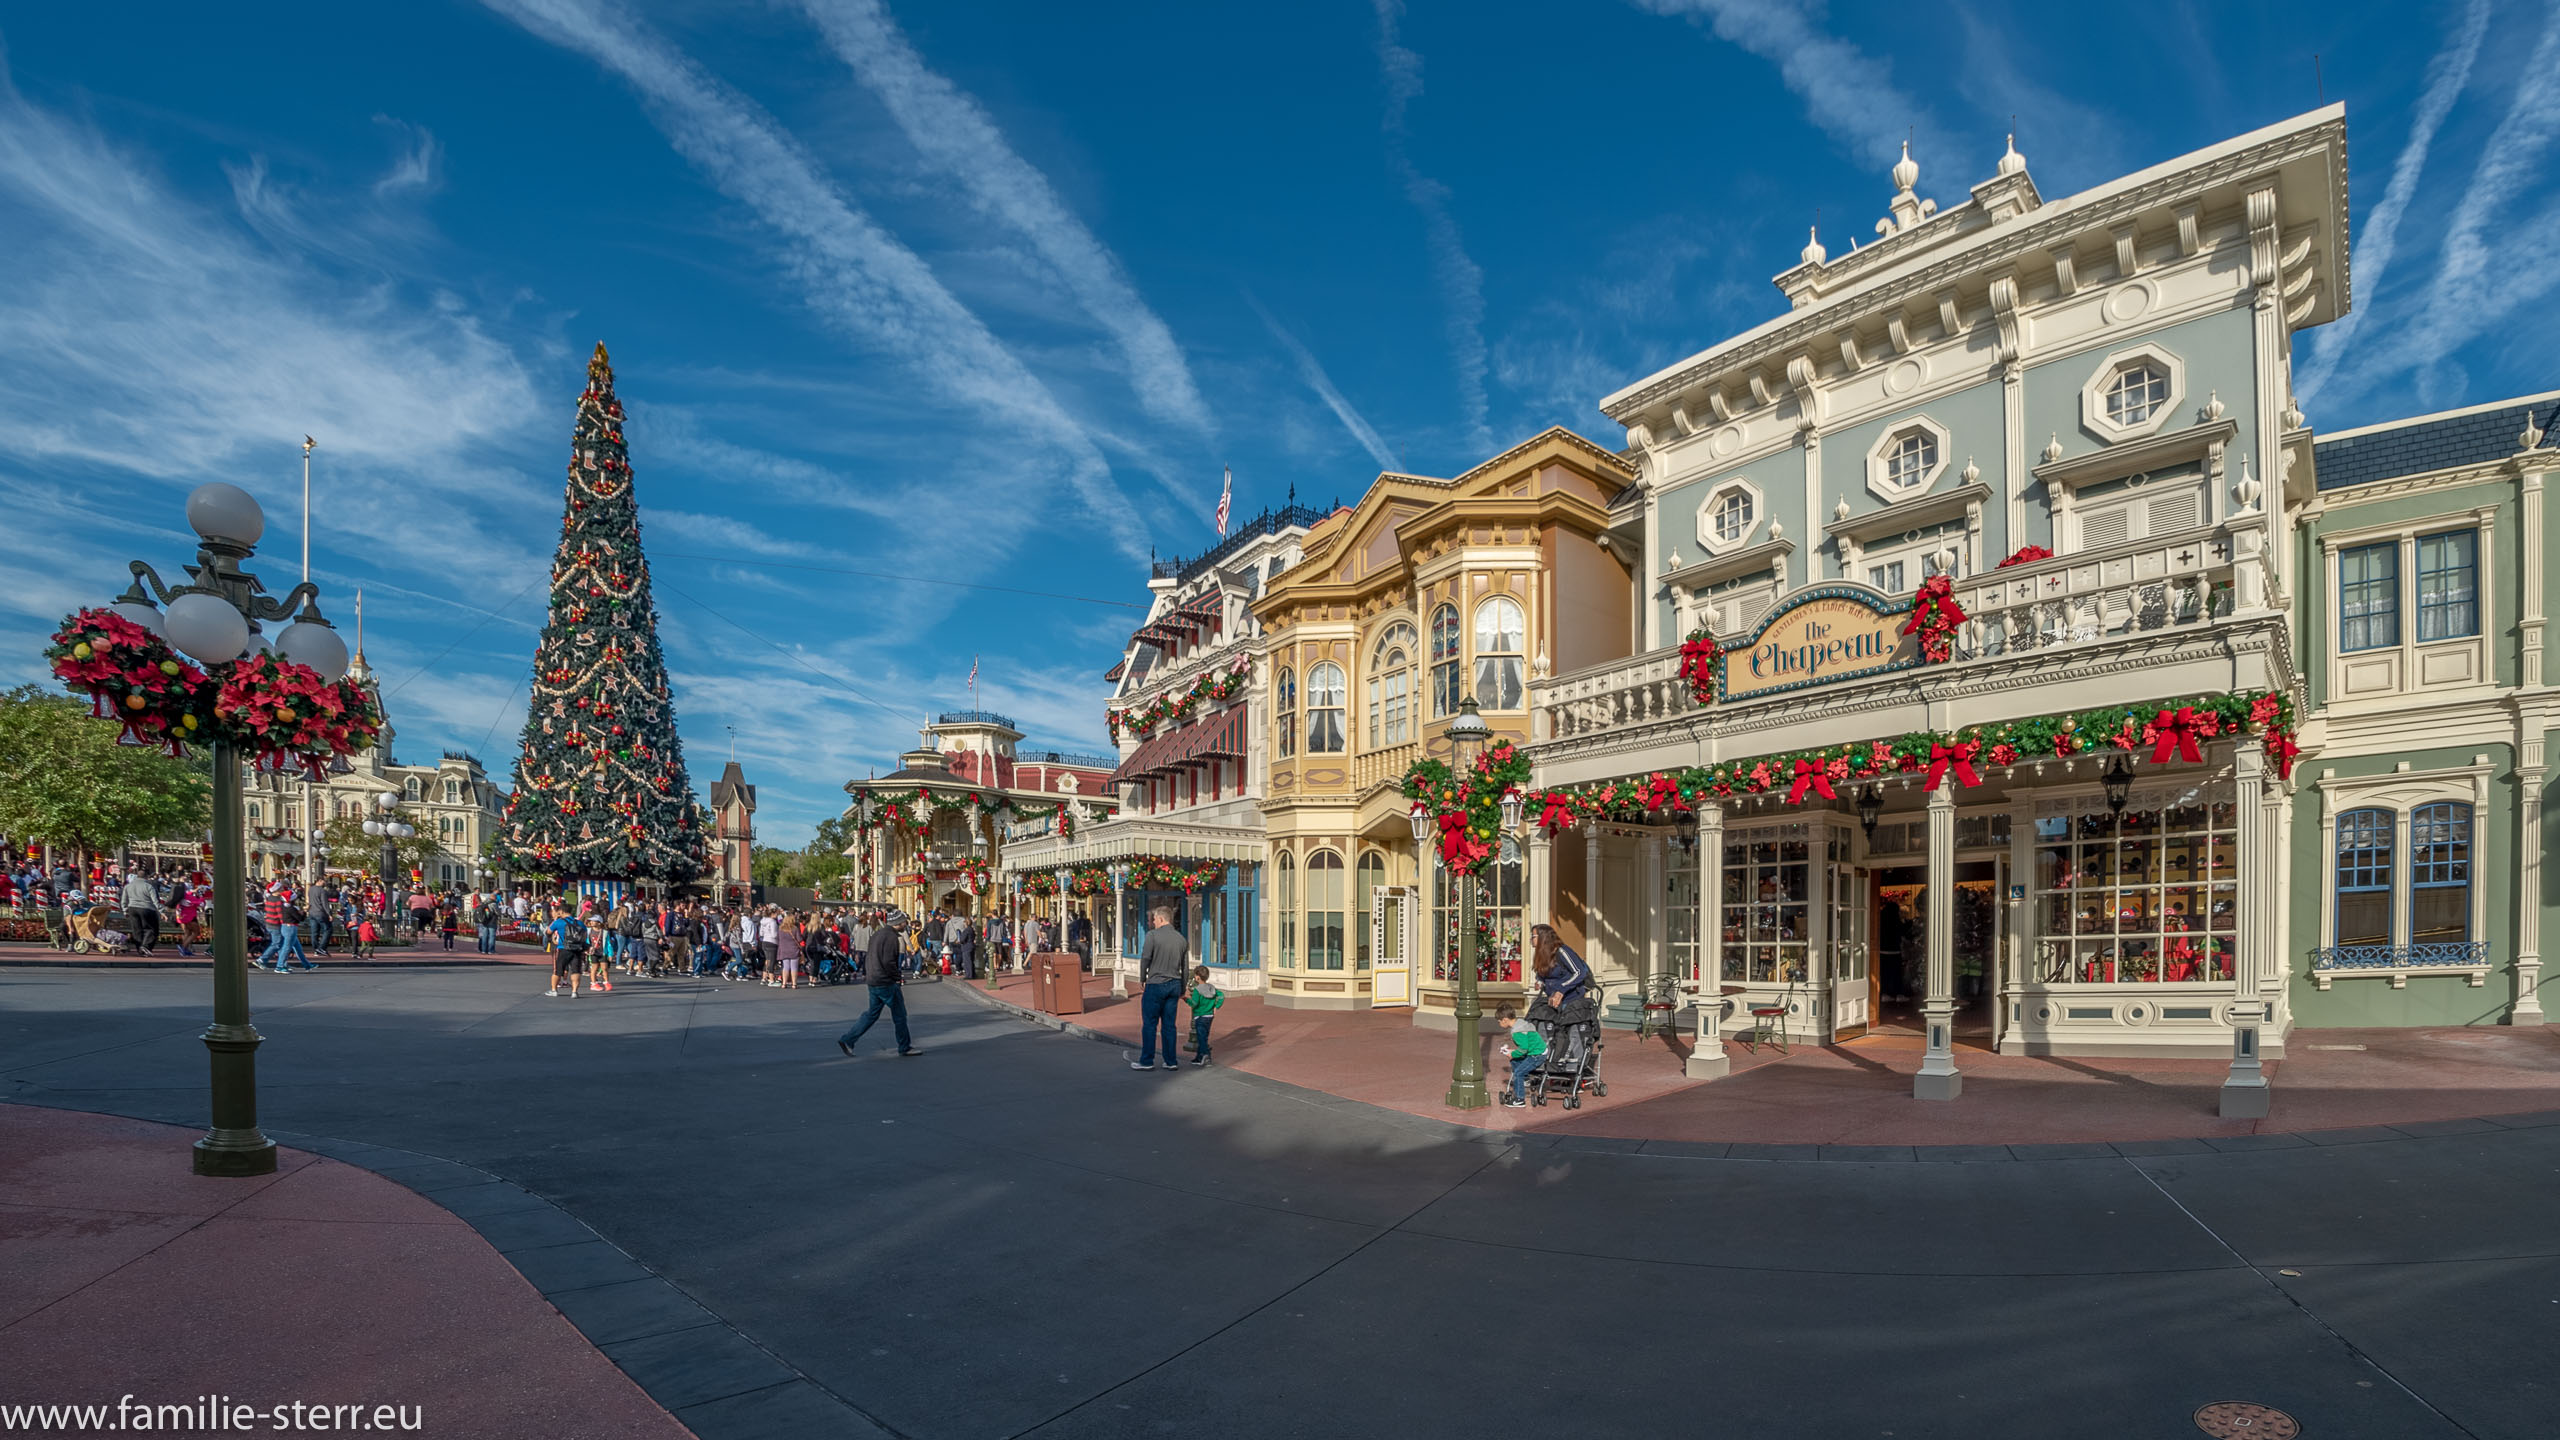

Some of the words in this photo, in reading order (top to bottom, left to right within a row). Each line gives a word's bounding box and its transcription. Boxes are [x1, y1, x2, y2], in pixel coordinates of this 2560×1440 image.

[1773, 608, 1813, 639] GENTLEMEN'S
[1805, 621, 1832, 641] the
[1750, 630, 1896, 680] Chapeau
